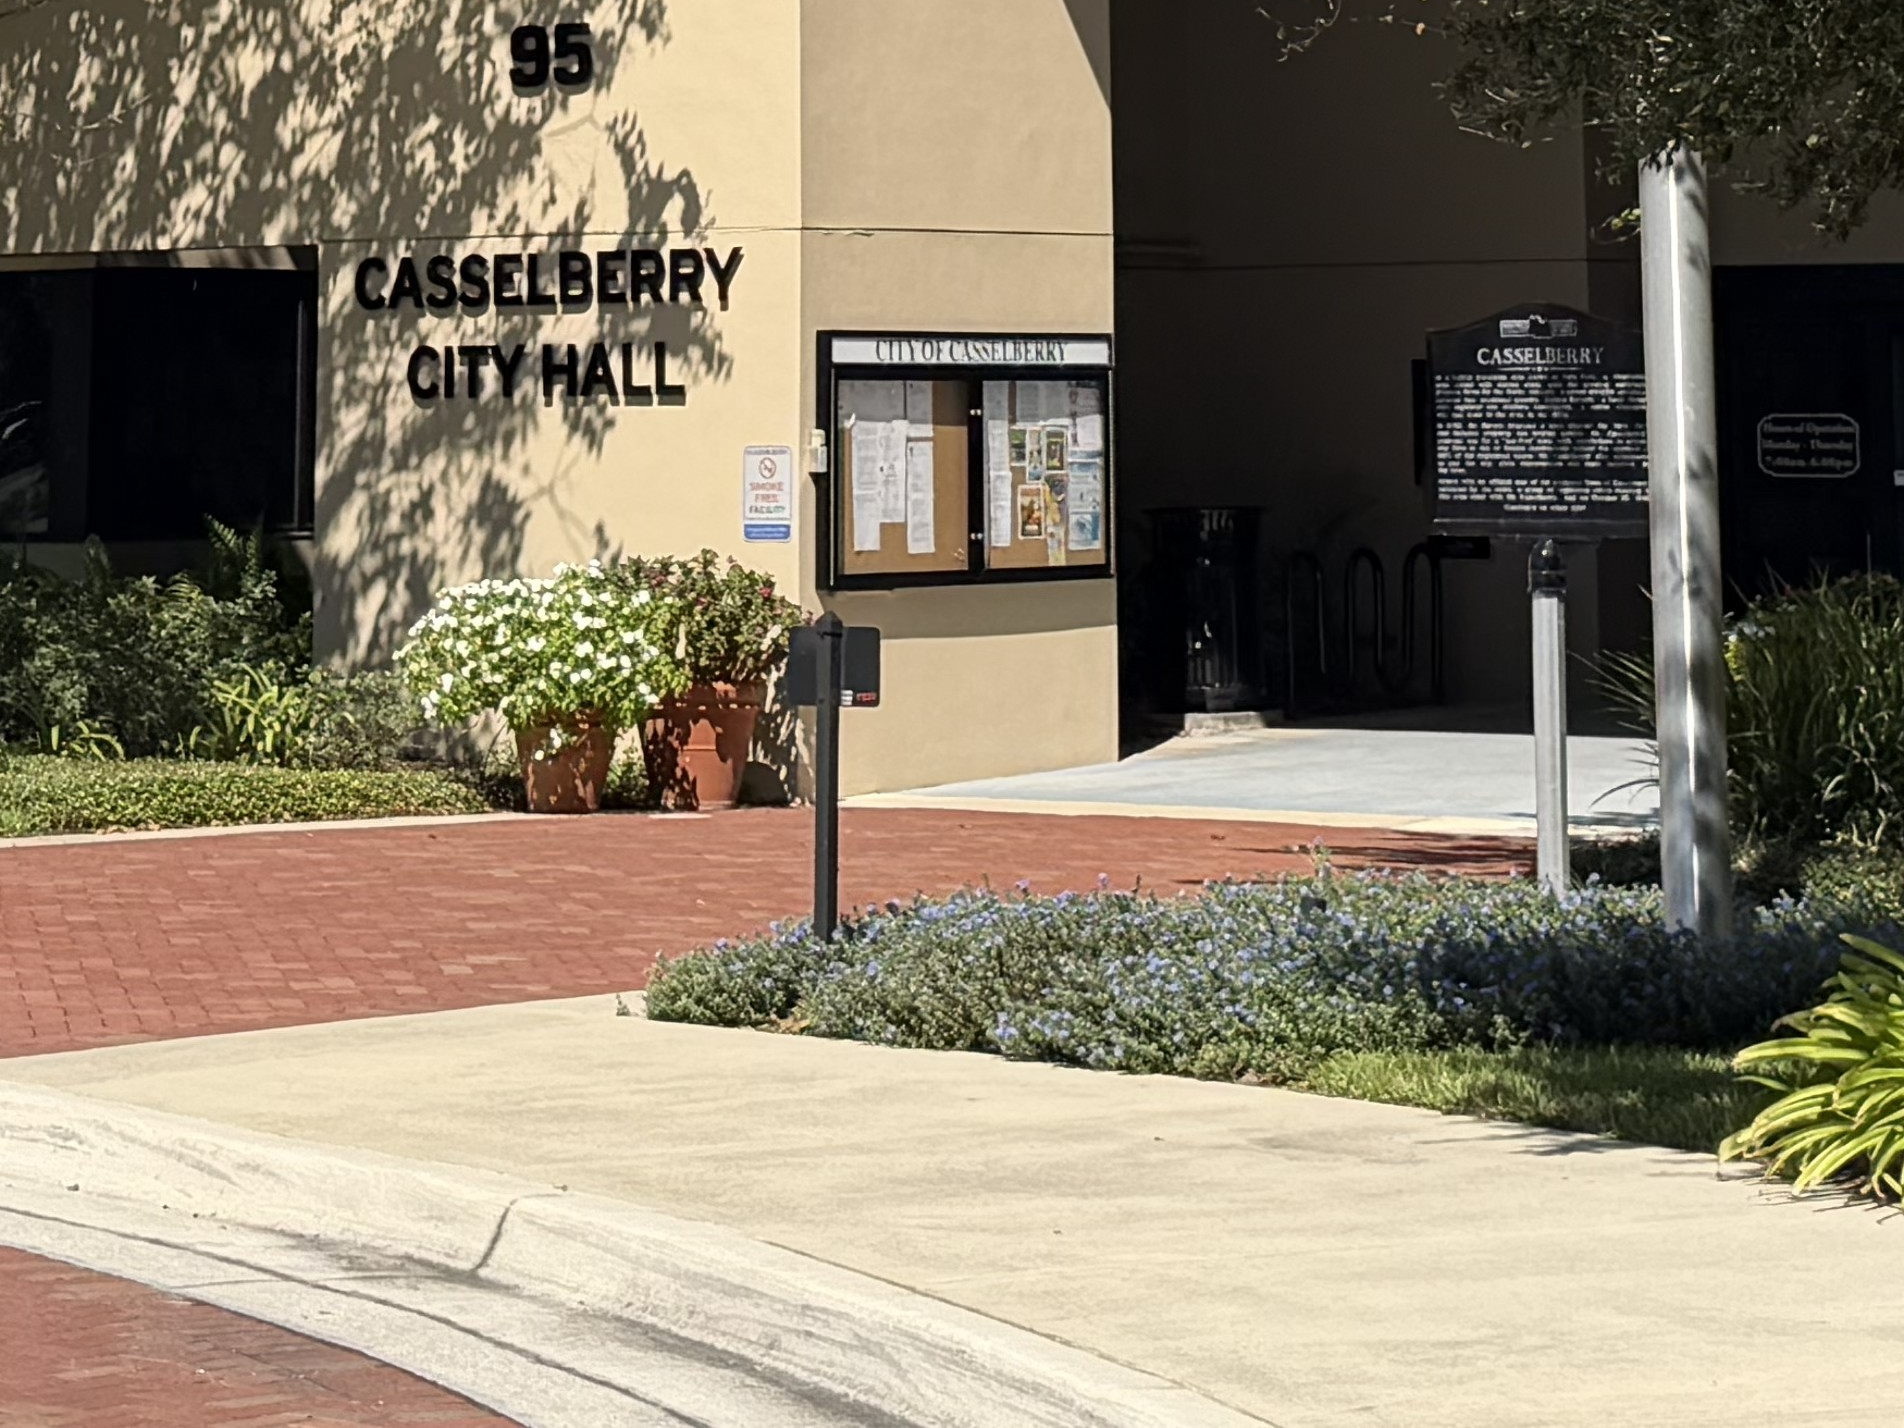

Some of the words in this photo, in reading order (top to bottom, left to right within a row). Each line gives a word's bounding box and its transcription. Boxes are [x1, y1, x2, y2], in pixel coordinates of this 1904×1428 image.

[509, 22, 594, 88] 95
[354, 246, 745, 311] CASSELBERRY
[406, 344, 526, 401] CITY
[542, 341, 688, 402] HALL
[875, 339, 916, 362] CITY
[921, 339, 944, 362] OF
[949, 339, 1066, 362] CASSELBERRY
[1476, 346, 1605, 365] CASSELBERRY
